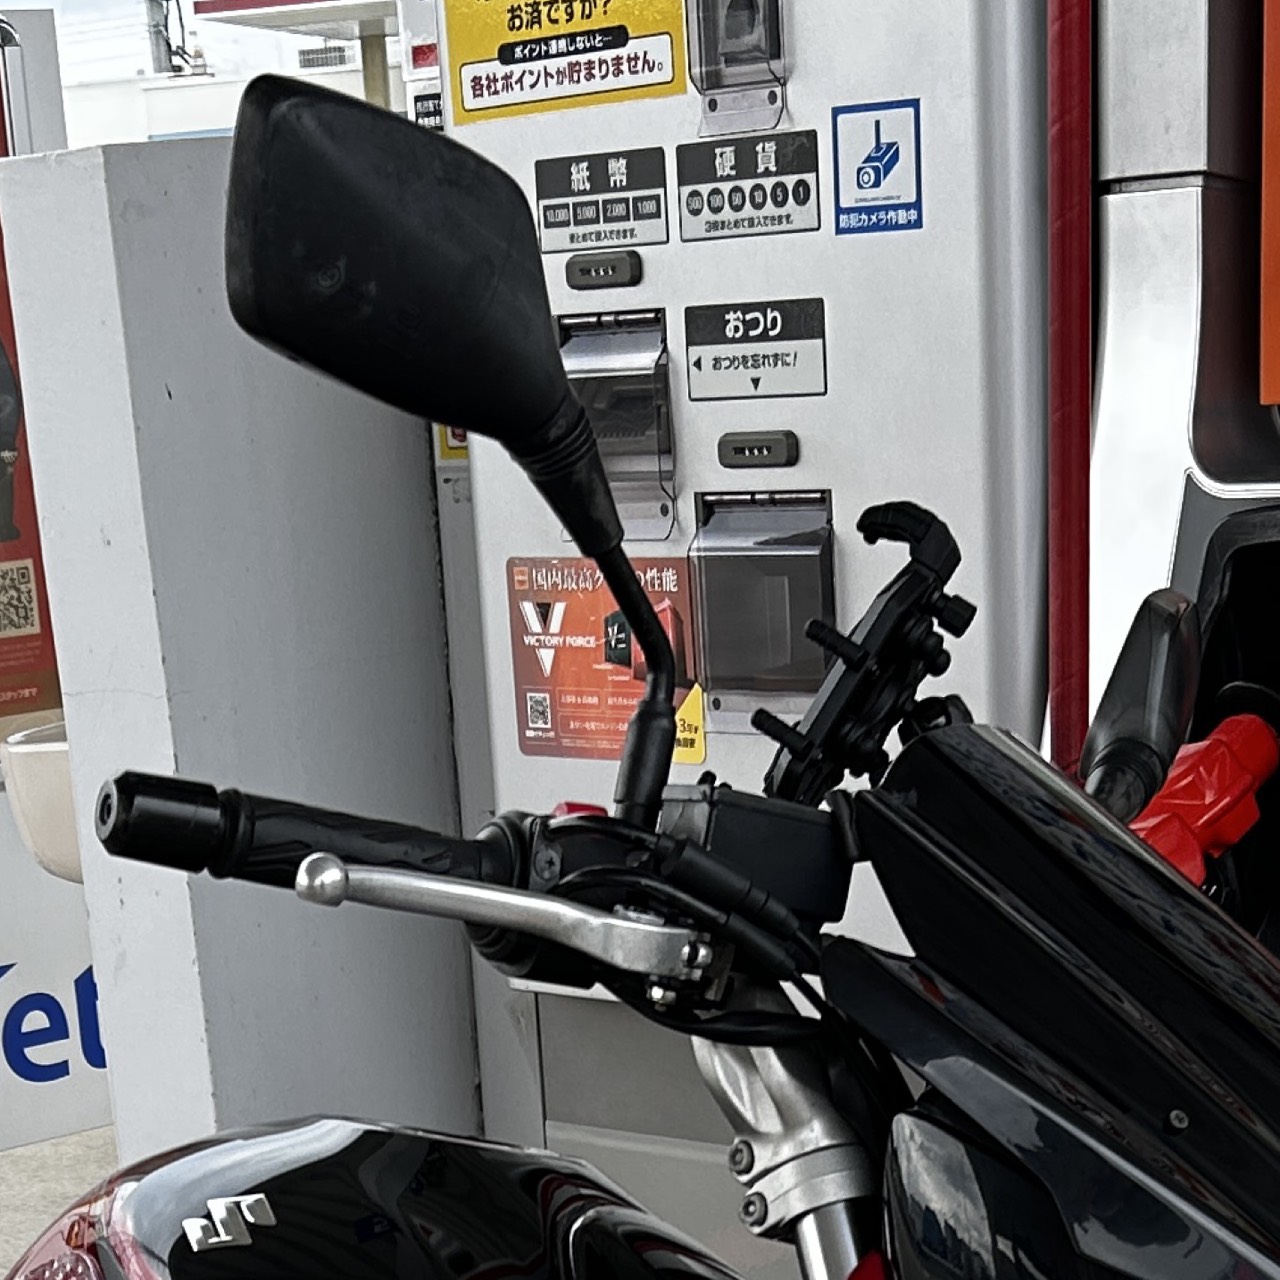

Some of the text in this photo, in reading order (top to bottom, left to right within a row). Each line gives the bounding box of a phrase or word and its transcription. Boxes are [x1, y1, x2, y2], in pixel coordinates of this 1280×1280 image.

[470, 51, 665, 99] 各社ポイントが貯まりません。
[570, 157, 628, 192] 紙幣
[714, 140, 778, 178] 硬貨
[839, 210, 919, 230] 防犯カメラ作動中
[724, 307, 782, 339] おつり
[712, 351, 798, 371] おつりを忘れずに!
[523, 634, 596, 649] VICTORY FORCE
